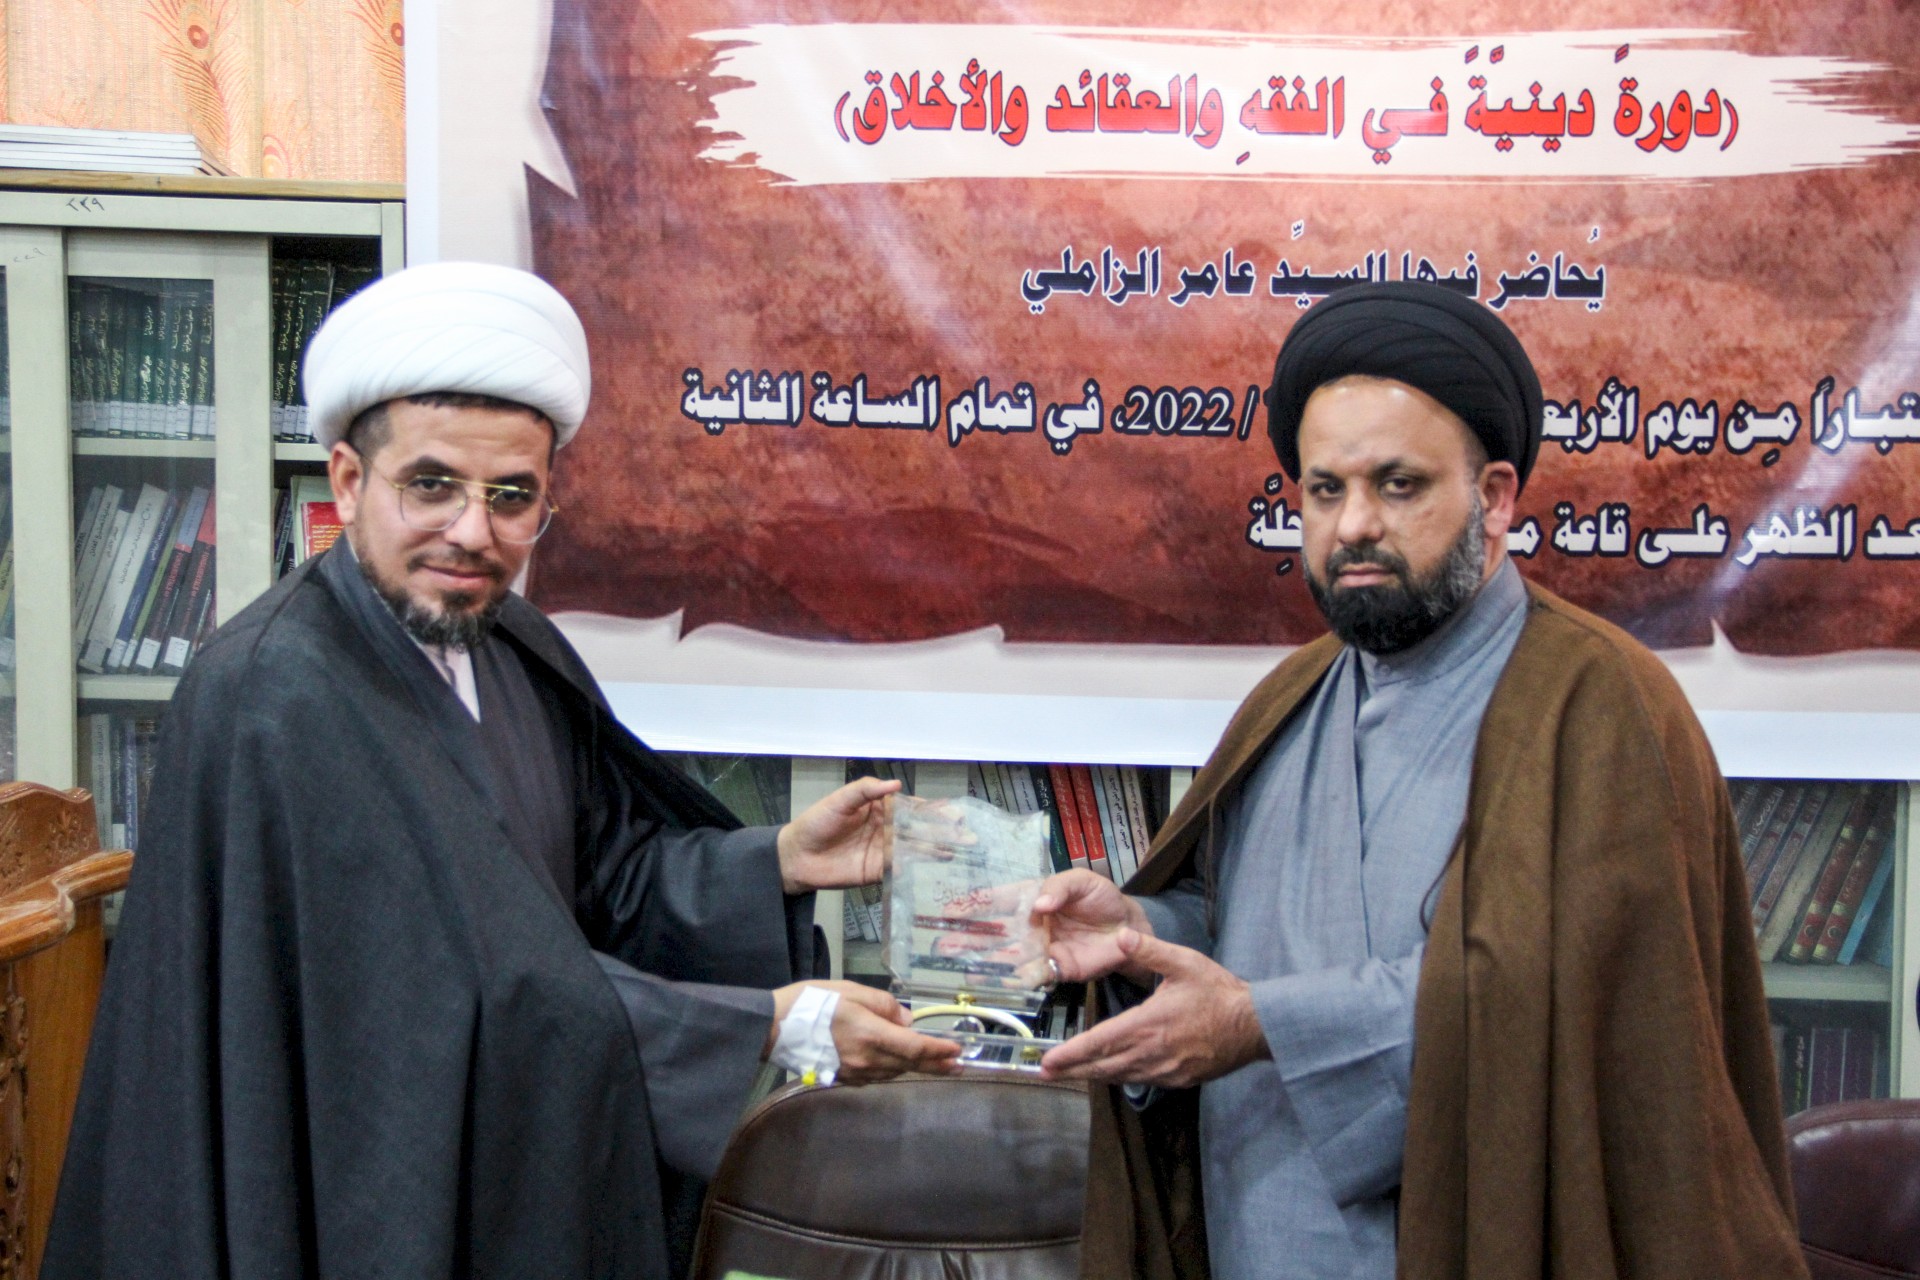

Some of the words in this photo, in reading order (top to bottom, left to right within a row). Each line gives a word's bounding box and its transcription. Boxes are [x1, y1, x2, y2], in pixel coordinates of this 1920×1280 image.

[833, 57, 1029, 147] والأخلاق)
[1045, 69, 1224, 150] والعقائد
[1361, 75, 1449, 165] في
[1021, 245, 1162, 314] الزاملي
[1168, 247, 1256, 307] عامر
[682, 371, 802, 432] الثانية
[811, 375, 939, 429] الساعة
[948, 379, 1035, 445] تمام
[1045, 381, 1102, 452] في
[1541, 379, 1638, 452] الأربع
[1646, 401, 1717, 457] يوم
[1553, 504, 1629, 554] قاعة
[1637, 506, 1729, 566] على
[1734, 507, 1855, 567] الظهر
